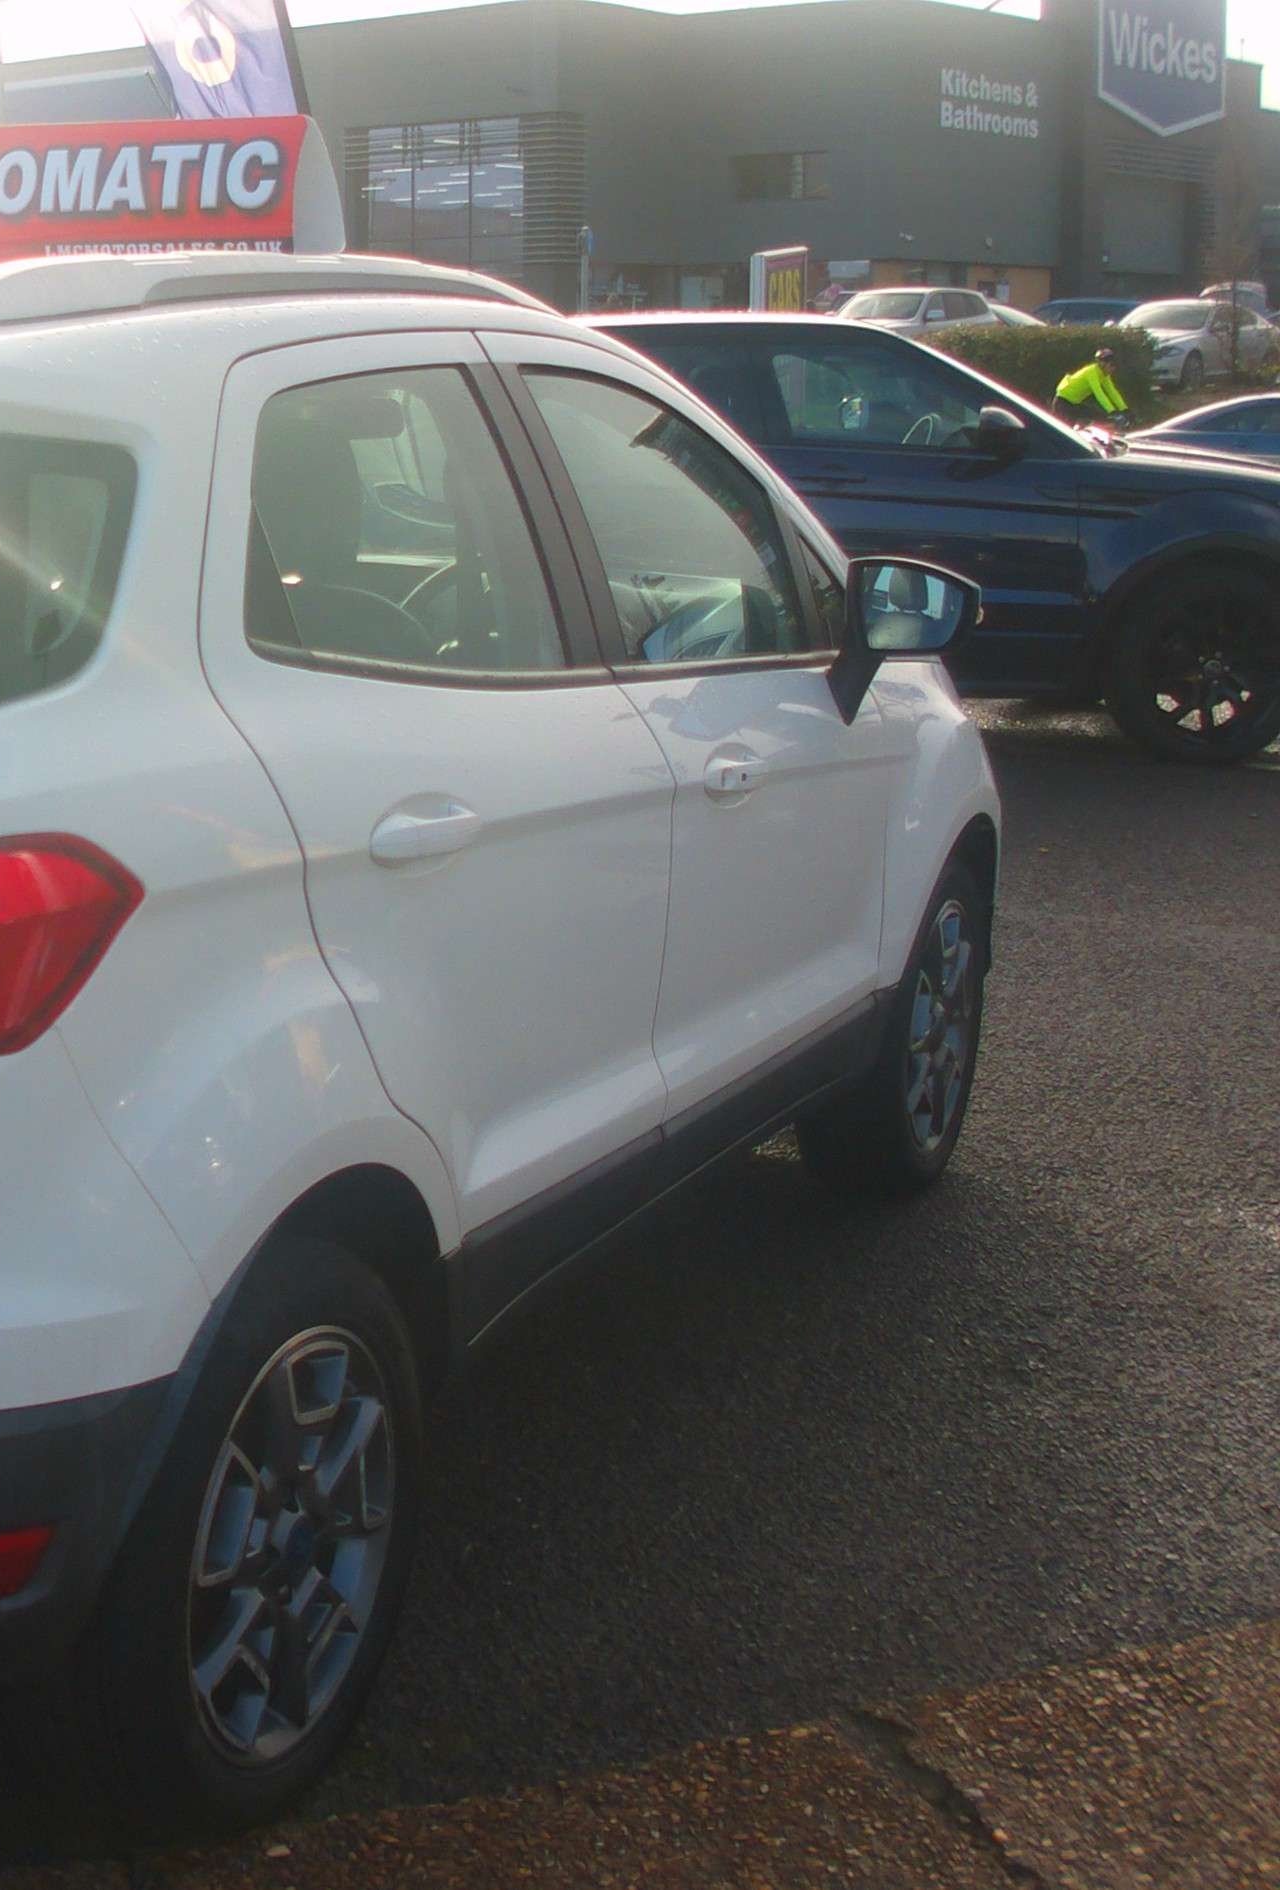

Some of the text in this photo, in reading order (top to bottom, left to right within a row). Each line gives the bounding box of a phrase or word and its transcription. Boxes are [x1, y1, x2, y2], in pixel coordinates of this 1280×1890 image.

[1108, 9, 1217, 83] Wickes
[940, 67, 1039, 108] Kitchens &
[940, 101, 1039, 139] Bathrooms
[768, 267, 800, 311] CARS
